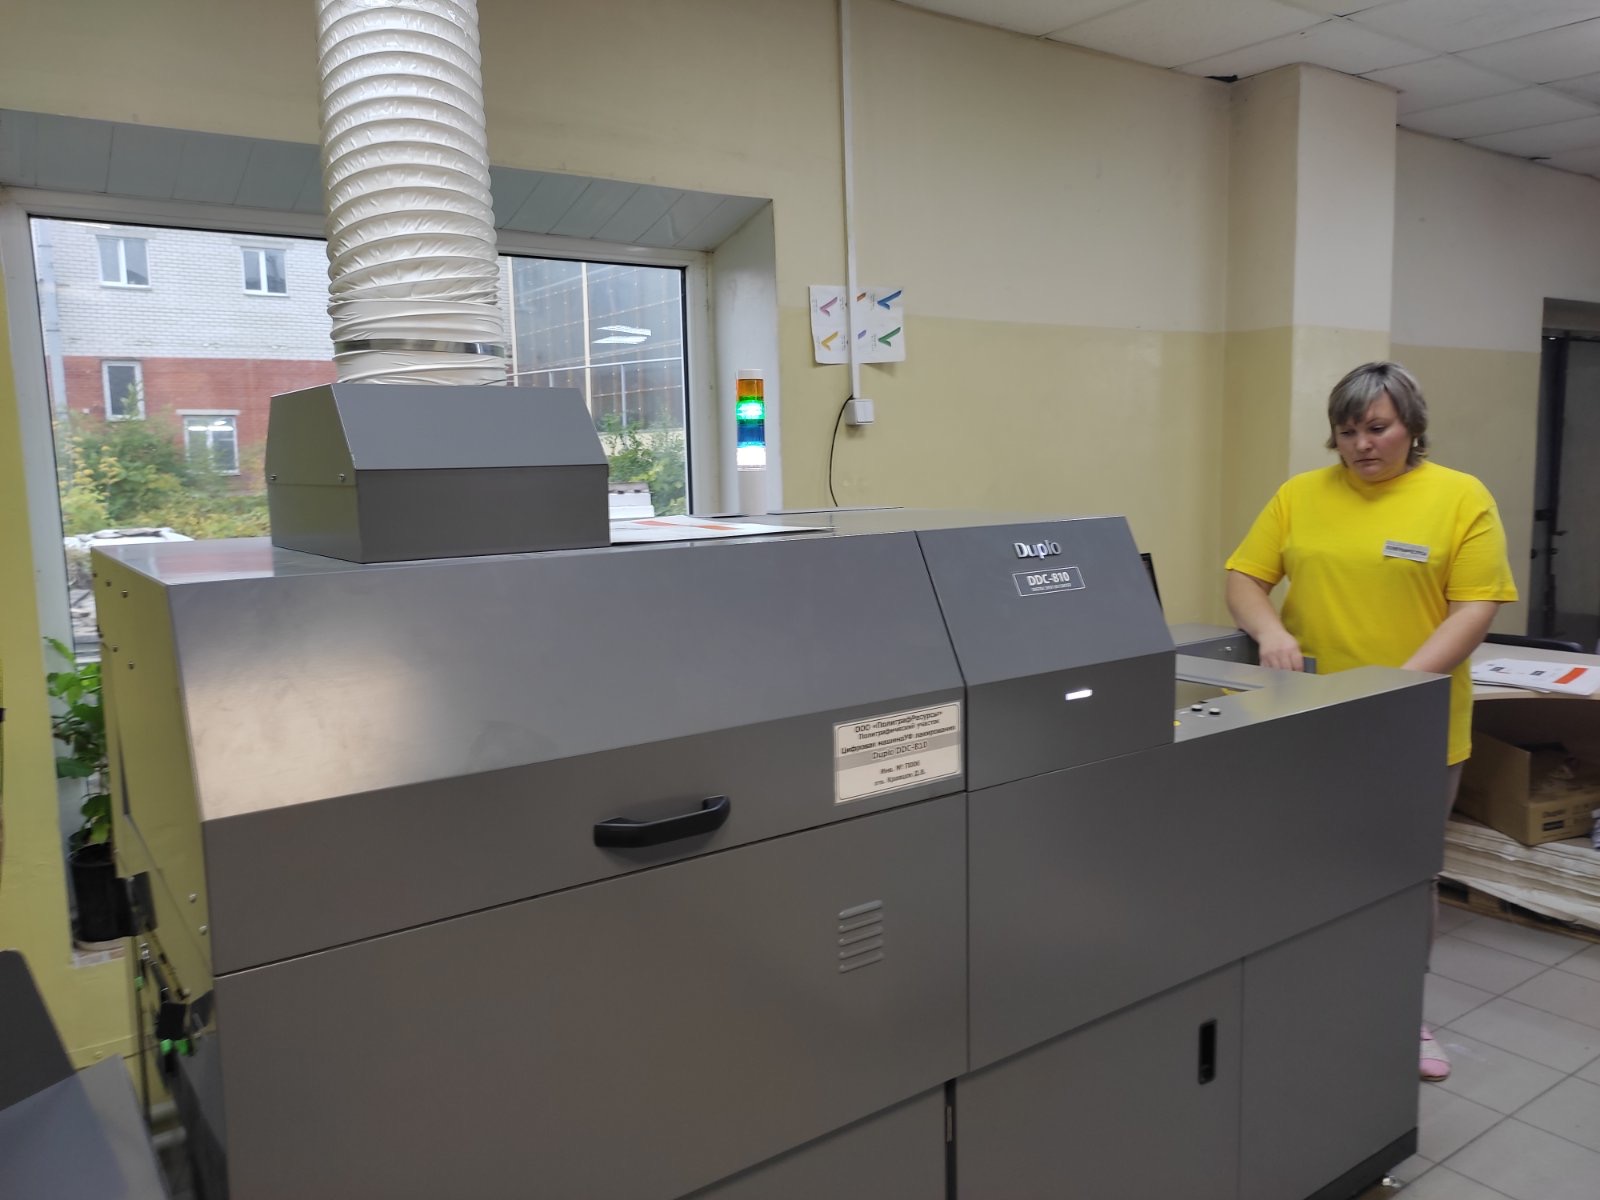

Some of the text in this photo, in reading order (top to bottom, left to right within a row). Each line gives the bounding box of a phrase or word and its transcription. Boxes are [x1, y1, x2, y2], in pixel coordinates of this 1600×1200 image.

[1013, 539, 1062, 559] Duplo
[1026, 571, 1070, 586] DDC-810
[855, 724, 871, 733] ООО
[917, 718, 939, 729] участок
[841, 741, 876, 754] Цифровая
[873, 741, 927, 760] Duplo DDC-810
